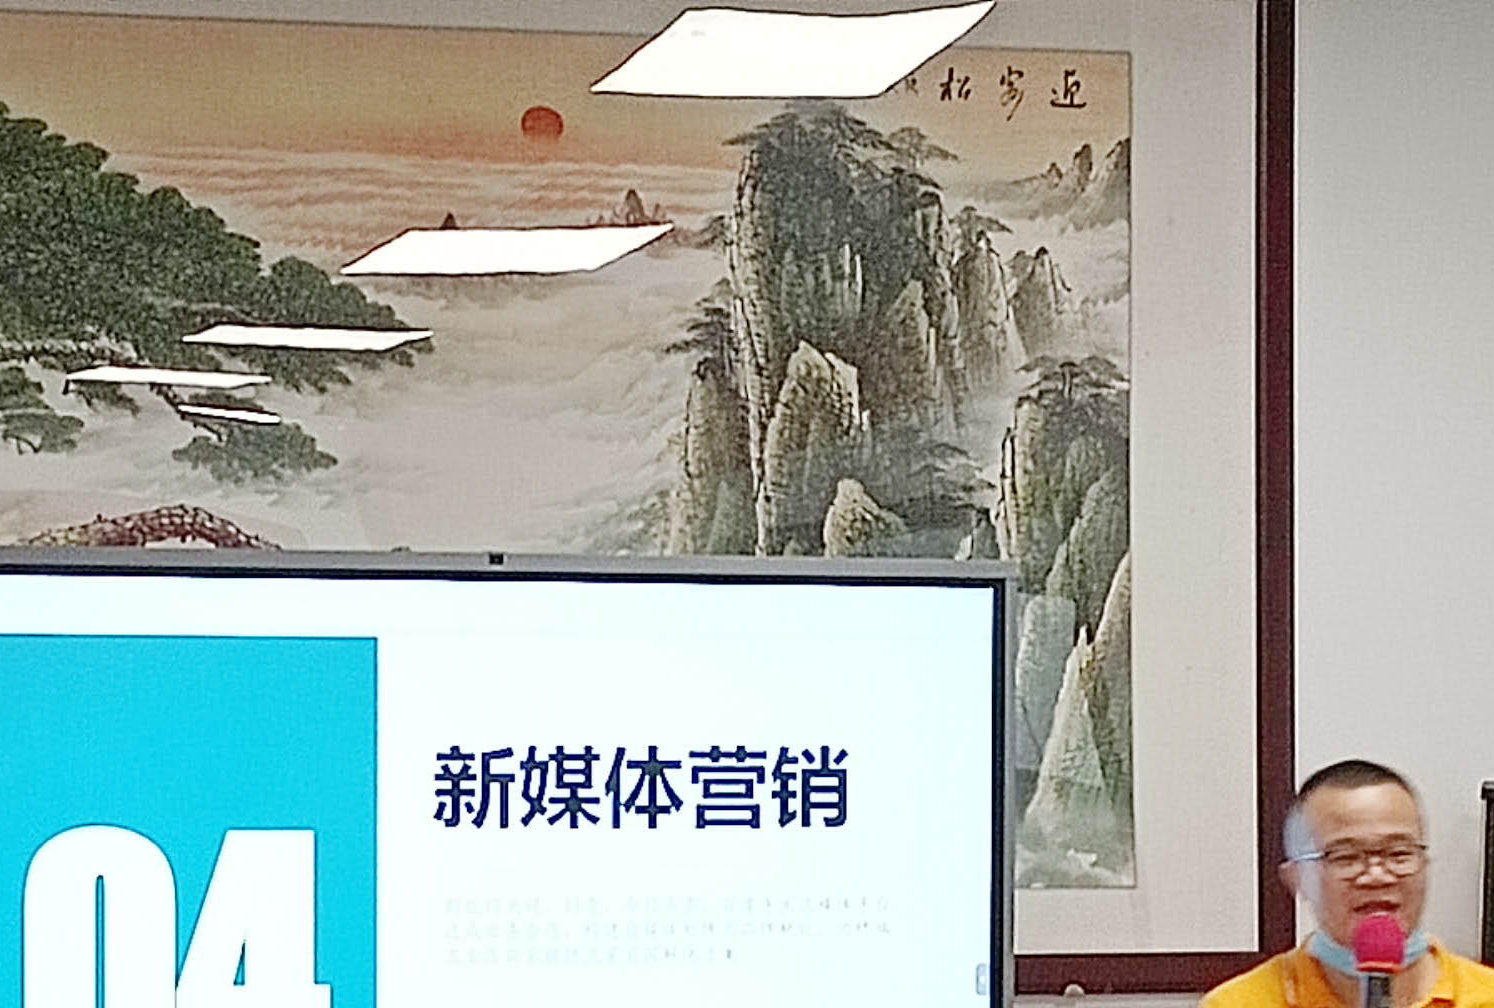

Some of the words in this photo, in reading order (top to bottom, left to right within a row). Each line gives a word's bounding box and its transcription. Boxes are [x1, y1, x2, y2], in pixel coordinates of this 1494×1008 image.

[434, 745, 850, 829] 新媒体营销
